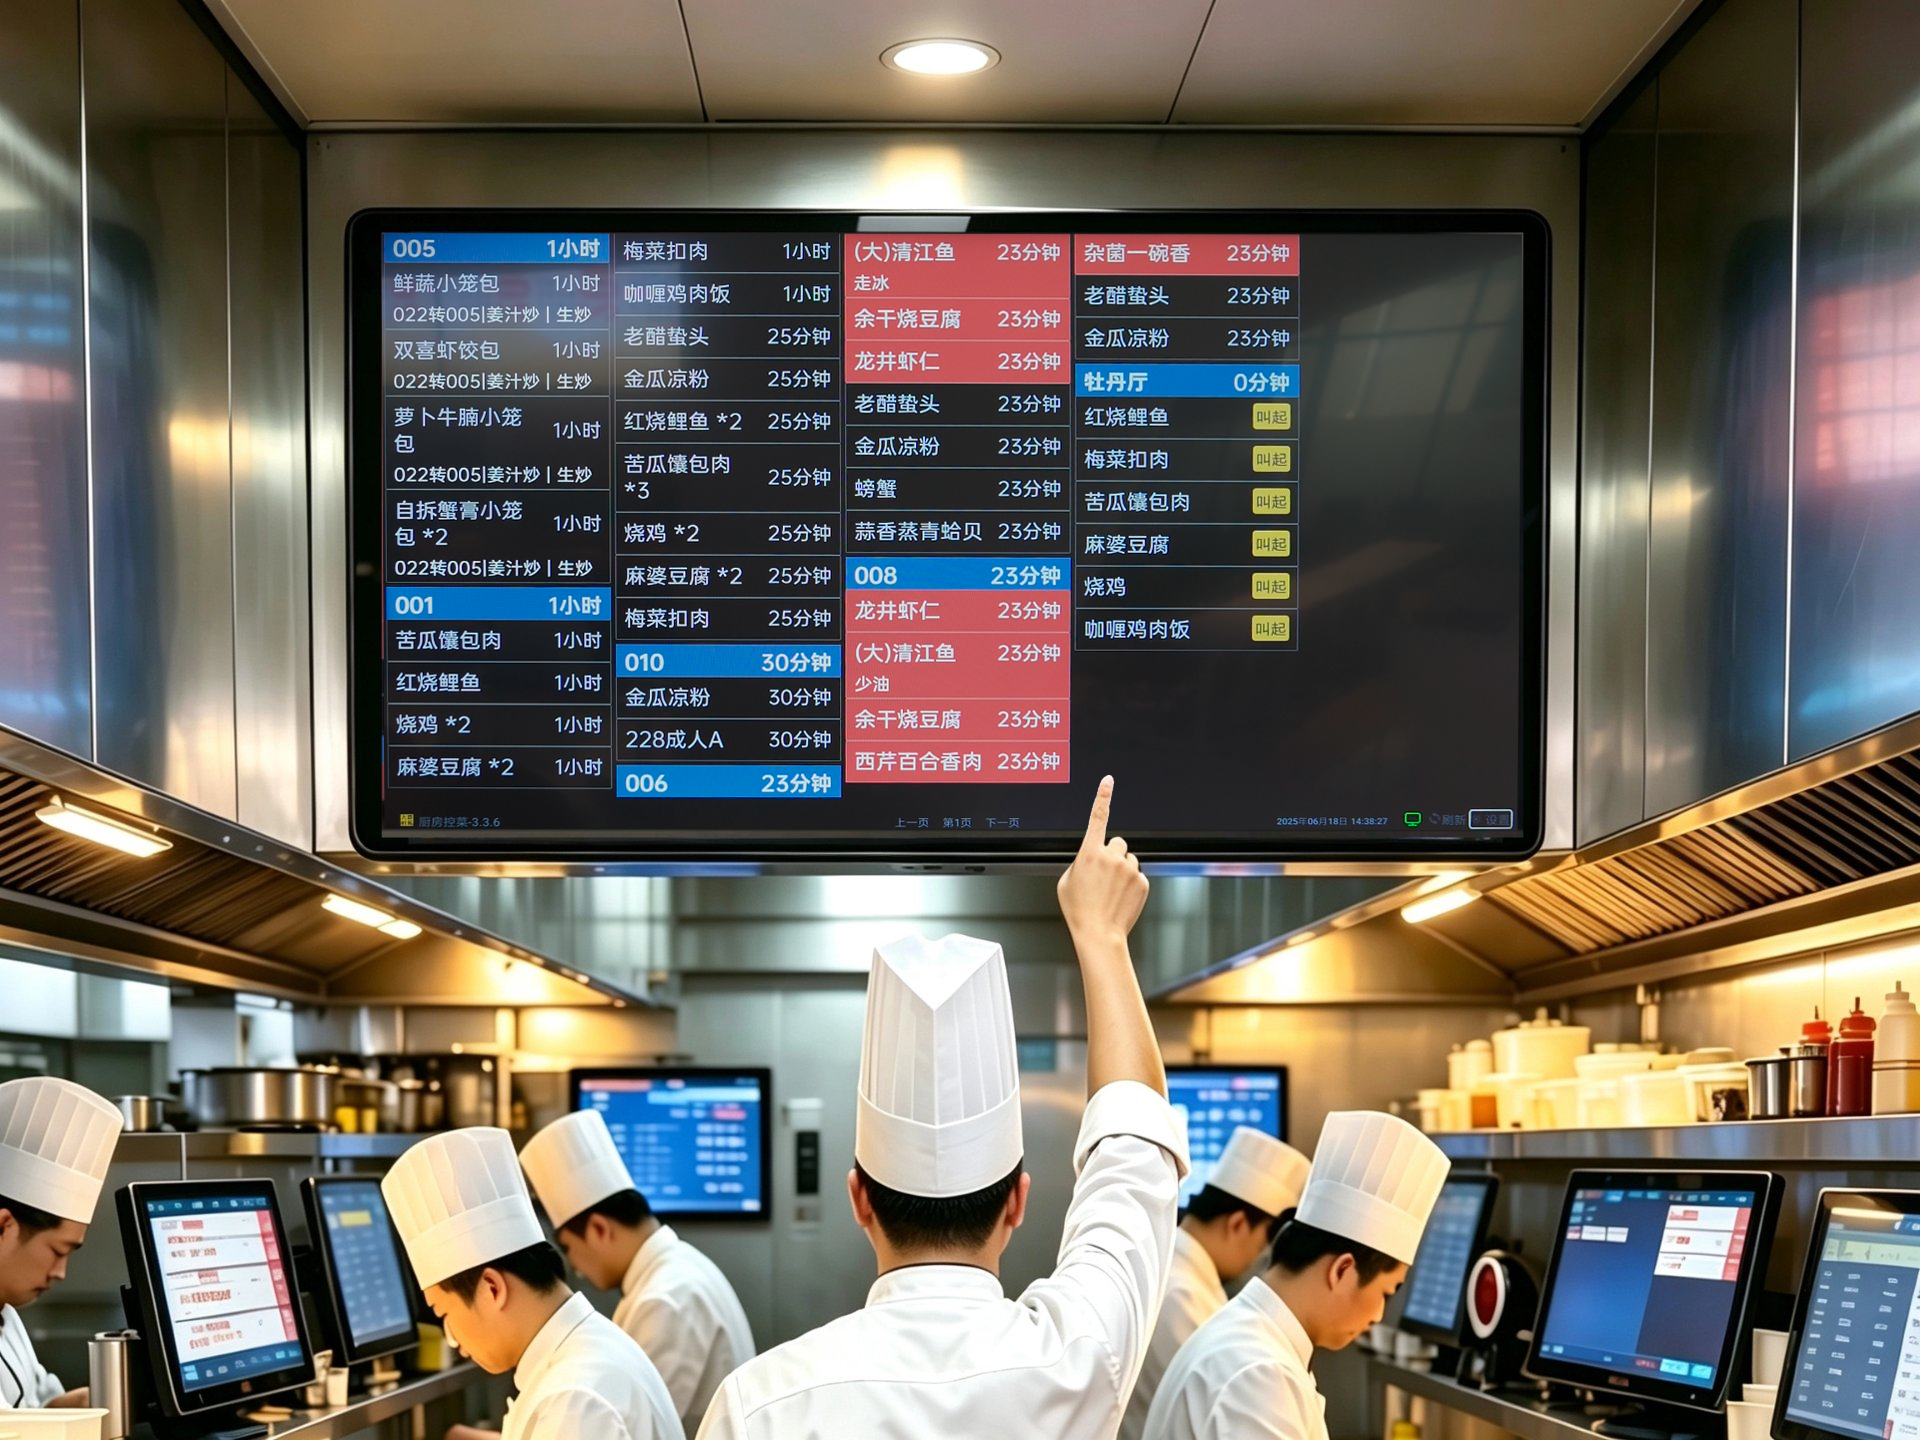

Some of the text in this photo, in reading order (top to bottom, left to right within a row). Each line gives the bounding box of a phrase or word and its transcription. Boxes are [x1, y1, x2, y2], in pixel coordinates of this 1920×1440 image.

[392, 239, 601, 259] 005 1小时
[623, 240, 831, 261] 梅菜扣肉 1小时
[854, 241, 1061, 263] (大)清江鱼 23分钟
[1084, 242, 1290, 263] 杂菌一碗香 23分钟
[393, 273, 601, 293] 鲜蔬小笼包 1小时
[853, 273, 890, 292] 走冰
[622, 283, 831, 304] 咖喱鸡肉饭 1小时
[1083, 285, 1290, 306] 老醋蛰头 23分钟
[556, 305, 592, 324] 生炒
[854, 308, 1061, 329] 余干烧豆腐 23分钟
[623, 325, 831, 347] 老醋蛰头 25分钟
[1084, 327, 1290, 348] 金瓜凉粉 23分钟
[393, 340, 601, 361] 双喜虾饺包 1小时
[854, 350, 1061, 372] 龙井虾仁 23分钟
[556, 372, 592, 390] 生炒
[623, 368, 831, 389] 金瓜凉粉 25分钟
[1083, 371, 1290, 393] 牡丹厅 0分钟
[854, 393, 1061, 414] 老醋蛰头 23分钟
[394, 406, 523, 427] 萝卜牛腩小笼
[623, 410, 710, 432] 红烧鲤鱼
[767, 412, 831, 431] 25分钟
[1084, 406, 1288, 427] 红烧鲤鱼 叫起
[553, 420, 601, 440] 1小时
[393, 433, 415, 454] 包
[854, 435, 1061, 457] 金瓜凉粉 23分钟
[1084, 449, 1288, 470] 梅菜扣肉 叫起
[557, 466, 592, 484] 生炒
[768, 467, 831, 487] 25分钟
[854, 478, 1061, 499] 螃蟹 23分钟
[396, 499, 523, 521] 自拆蟹膏小笼
[1256, 494, 1288, 510] 叫起
[553, 514, 602, 533] 1小时
[624, 522, 666, 543] 烧鸡
[768, 523, 832, 543] 25分钟
[854, 521, 1061, 542] 蒜香蒸青蛤贝 23分钟
[394, 526, 416, 547] 包
[1084, 534, 1288, 555] 麻婆豆腐 叫起
[557, 559, 593, 577] 生炒
[624, 565, 711, 586] 麻婆豆腐
[768, 566, 832, 586] 25分钟
[853, 566, 1061, 586] 008 23分钟
[1083, 576, 1288, 597] 烧鸡 叫起
[394, 595, 602, 616] 001 1小时
[854, 600, 1061, 621] 龙井虾仁 23分钟
[624, 607, 832, 629] 梅菜扣肉 25分钟
[1084, 619, 1287, 640] 咖喱鸡肉饭 叫起
[554, 631, 602, 650] 1小时
[624, 652, 832, 673] 010 30分钟
[855, 642, 1061, 664] (大)清江鱼 23分钟
[395, 672, 603, 693] 红烧鲤鱼 1小时
[854, 675, 890, 693] 少油
[625, 686, 831, 708] 金瓜凉粉 30分钟
[395, 713, 438, 735] 烧鸡
[554, 715, 603, 734] 1小时
[854, 708, 1061, 730] 余干烧豆腐 23分钟
[625, 729, 832, 749] 228成人A 30分钟
[397, 756, 482, 777] 麻婆豆腐
[554, 757, 603, 776] 1小时
[855, 750, 1061, 772] 西芹百合香肉 23分钟
[625, 772, 832, 794] 006 23分钟
[895, 817, 1020, 828] 上一页 第1页 下一页
[1276, 816, 1388, 826] 2025年06月18日 14:38:27
